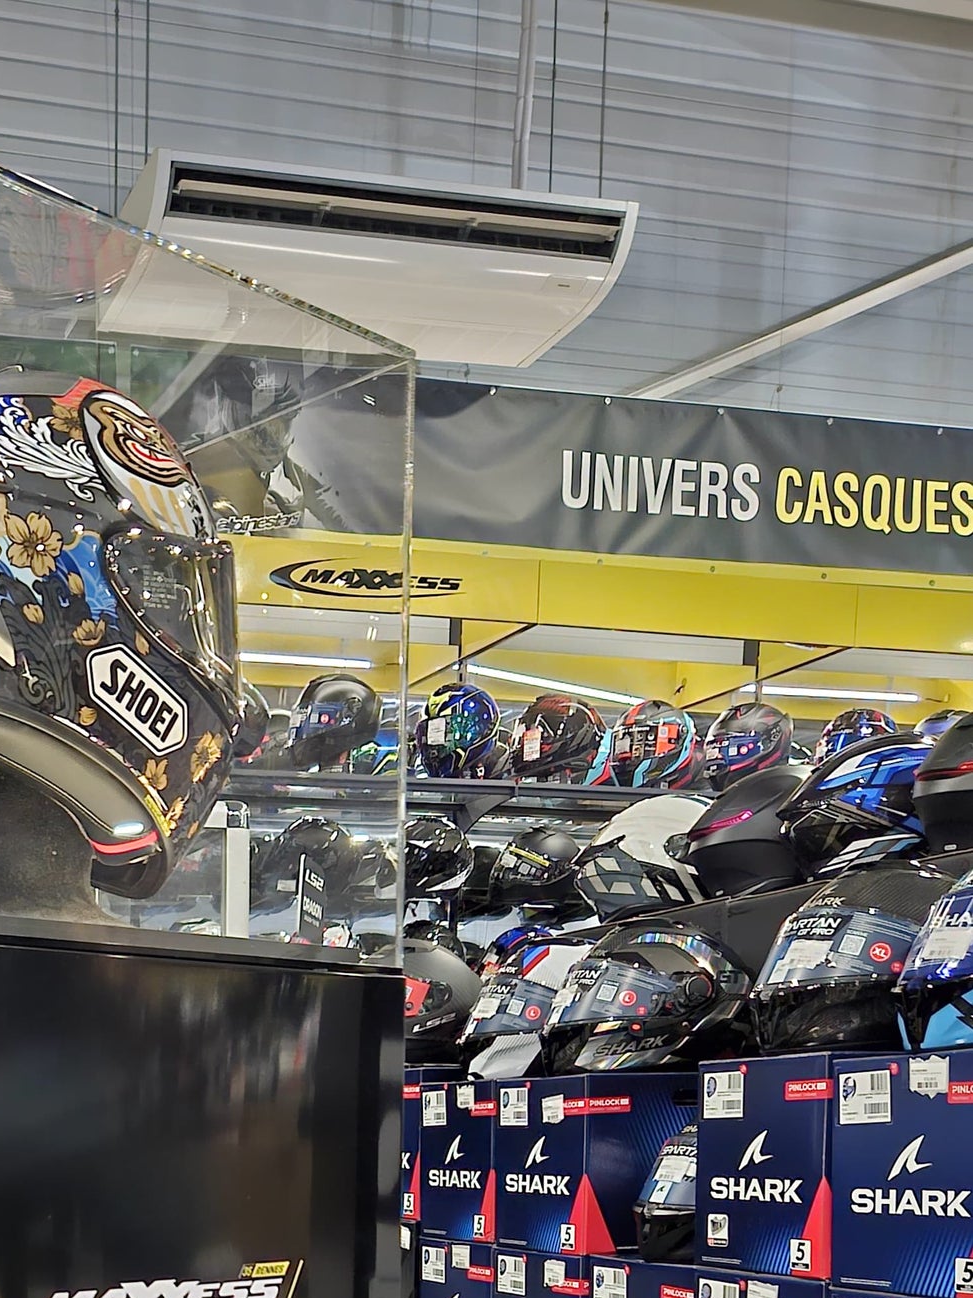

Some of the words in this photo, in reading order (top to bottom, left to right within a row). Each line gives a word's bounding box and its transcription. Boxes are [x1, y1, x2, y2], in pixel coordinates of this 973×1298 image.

[561, 449, 761, 522] UNIVERS
[775, 467, 973, 536] CASQUES
[217, 512, 301, 534] alpinestars
[299, 568, 463, 591] MAXXESS
[100, 659, 179, 743] SHOEI
[305, 869, 324, 892] LS2
[872, 947, 887, 957] XL
[412, 1012, 457, 1034] LS2
[594, 1034, 669, 1057] SHARK
[788, 1082, 817, 1092] PINLOCK
[589, 1098, 620, 1107] PINLOCK
[429, 1169, 481, 1190] SHARK
[505, 1173, 570, 1196] SHARK
[710, 1177, 803, 1203] SHARK
[405, 1195, 412, 1208] 5
[850, 1188, 971, 1218] SHARK
[476, 1217, 483, 1231] 5
[564, 1226, 572, 1242] 5
[796, 1242, 805, 1261] 5
[256, 1263, 286, 1277] RENNES
